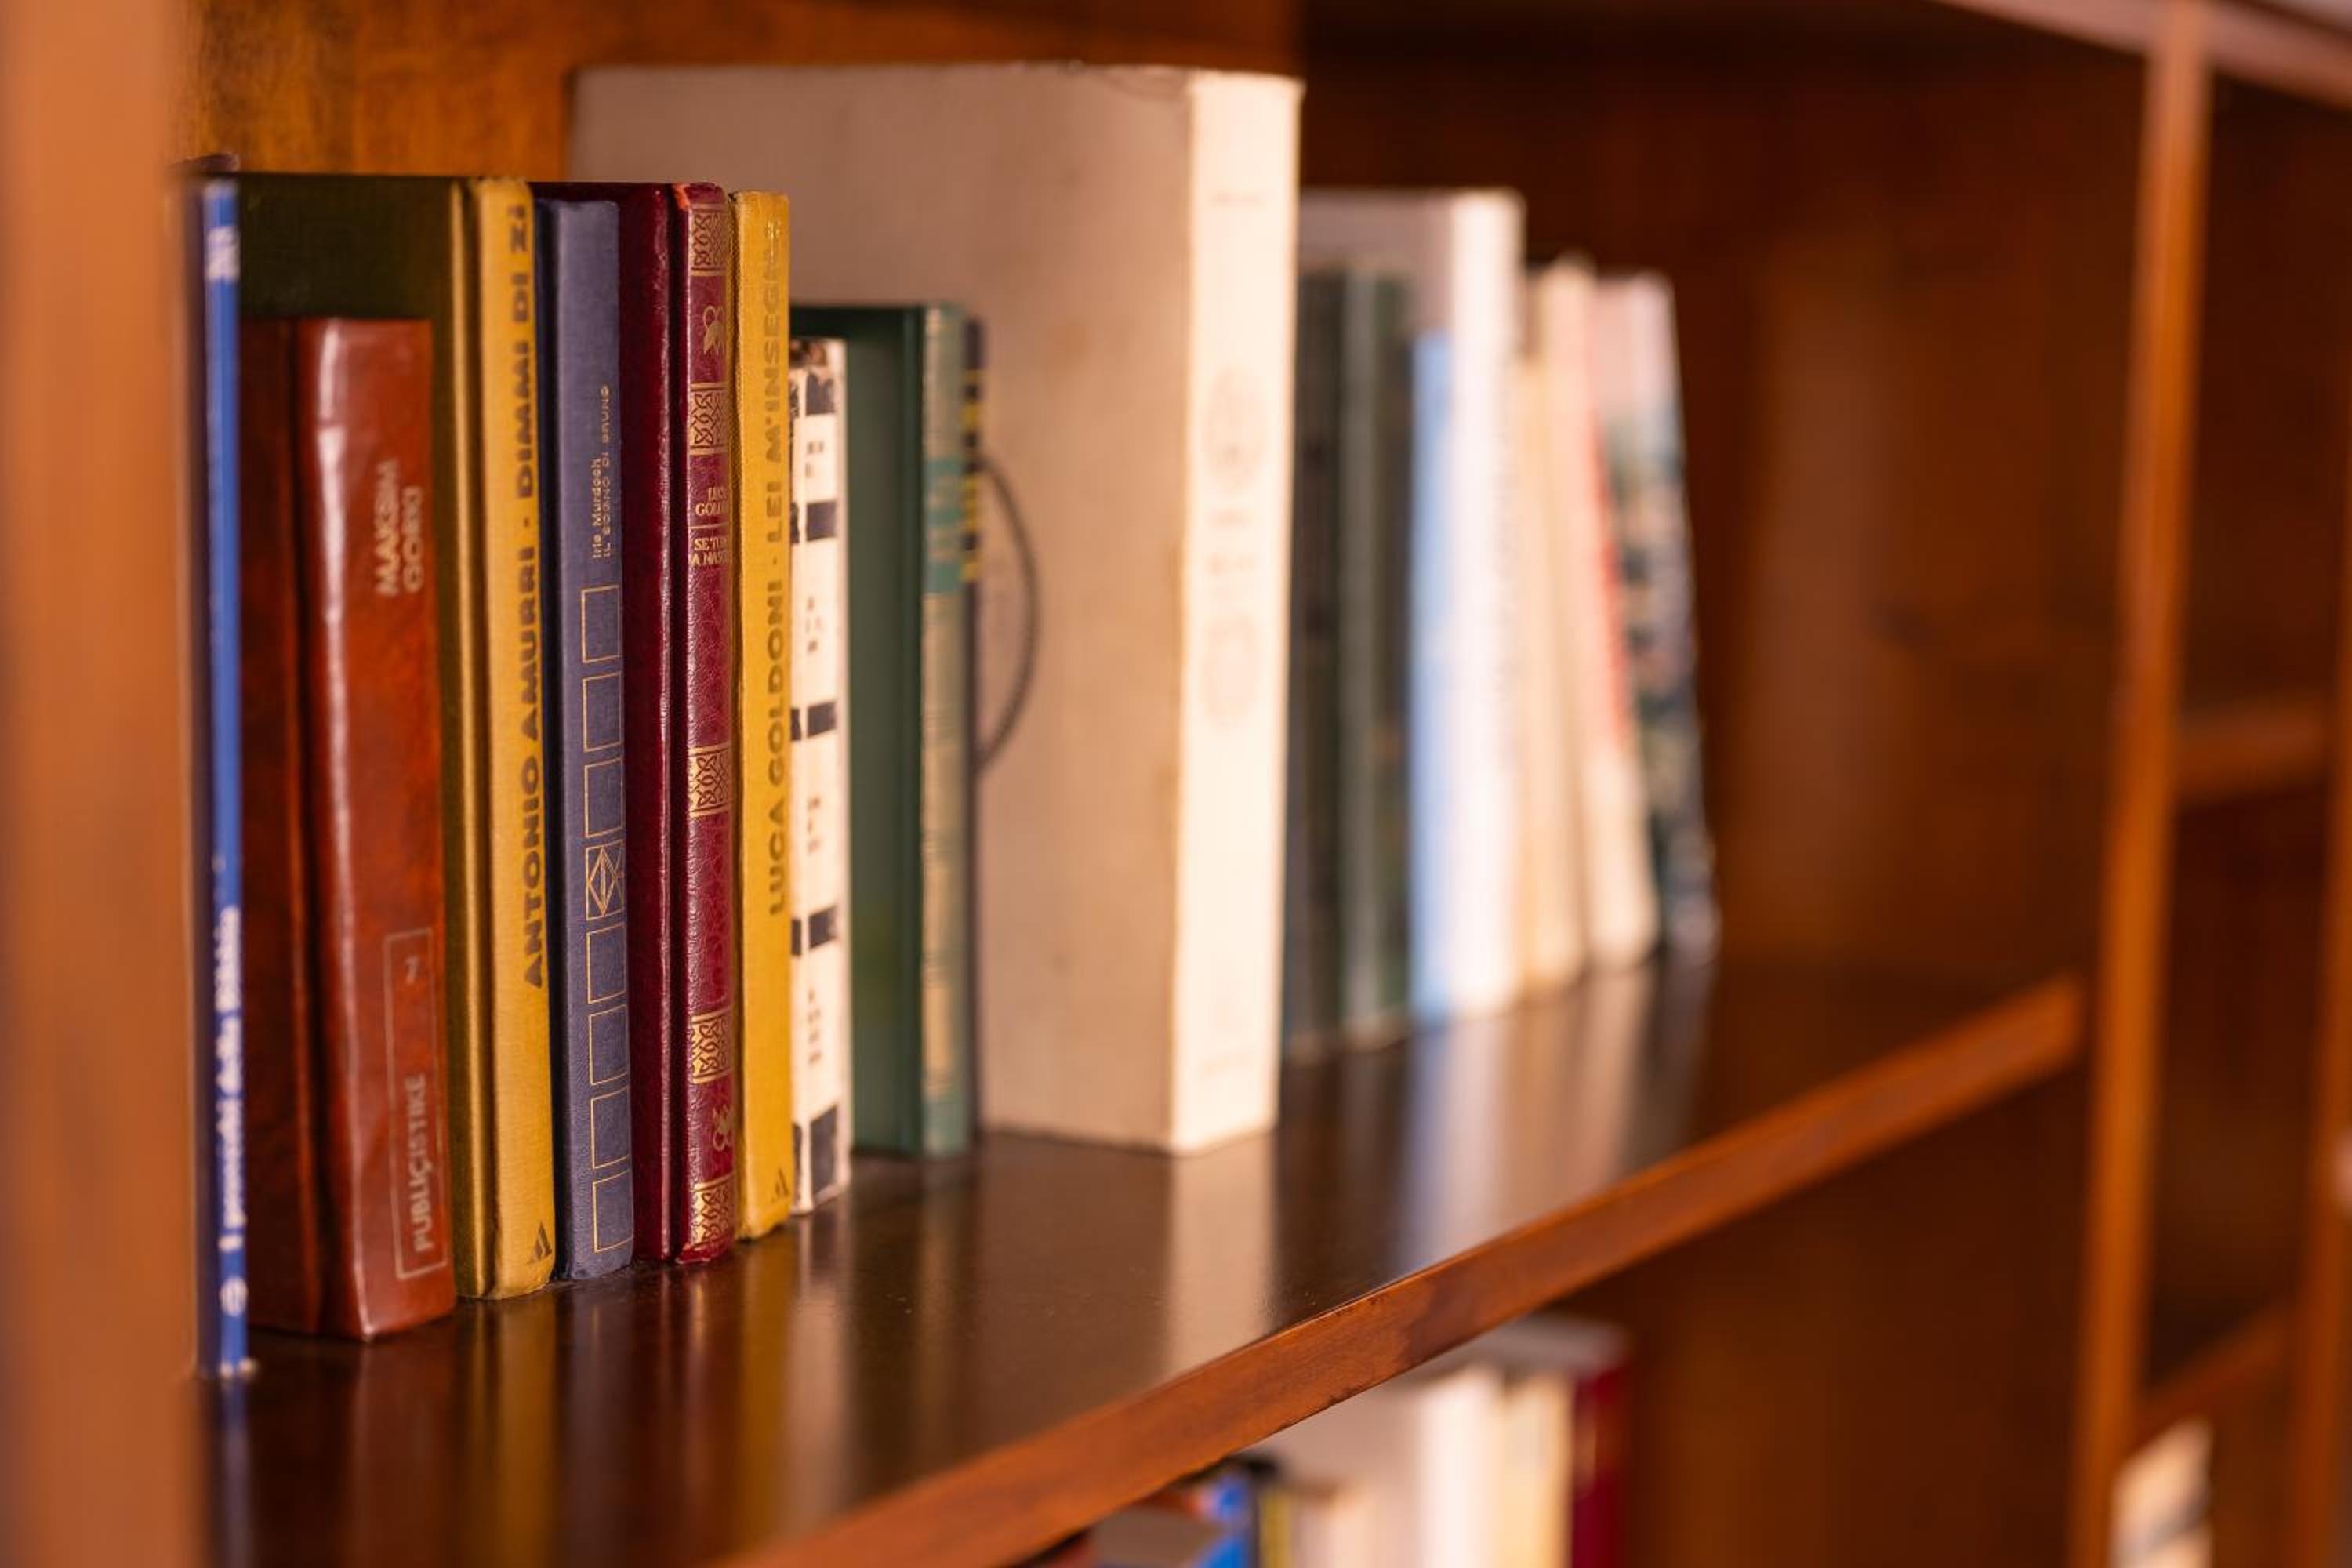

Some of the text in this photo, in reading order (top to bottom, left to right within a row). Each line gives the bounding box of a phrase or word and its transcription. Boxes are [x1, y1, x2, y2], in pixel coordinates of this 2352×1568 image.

[511, 274, 531, 322] DI
[515, 343, 533, 499] DIMMI
[591, 458, 601, 527] Murdoch
[764, 481, 784, 543] LEI
[517, 547, 541, 741] AMURRI
[765, 579, 786, 782] GOLDONI
[521, 756, 544, 990] ANTONIO
[768, 800, 786, 917] LUCA
[404, 1073, 434, 1254] PUBLIÇISTIKE
